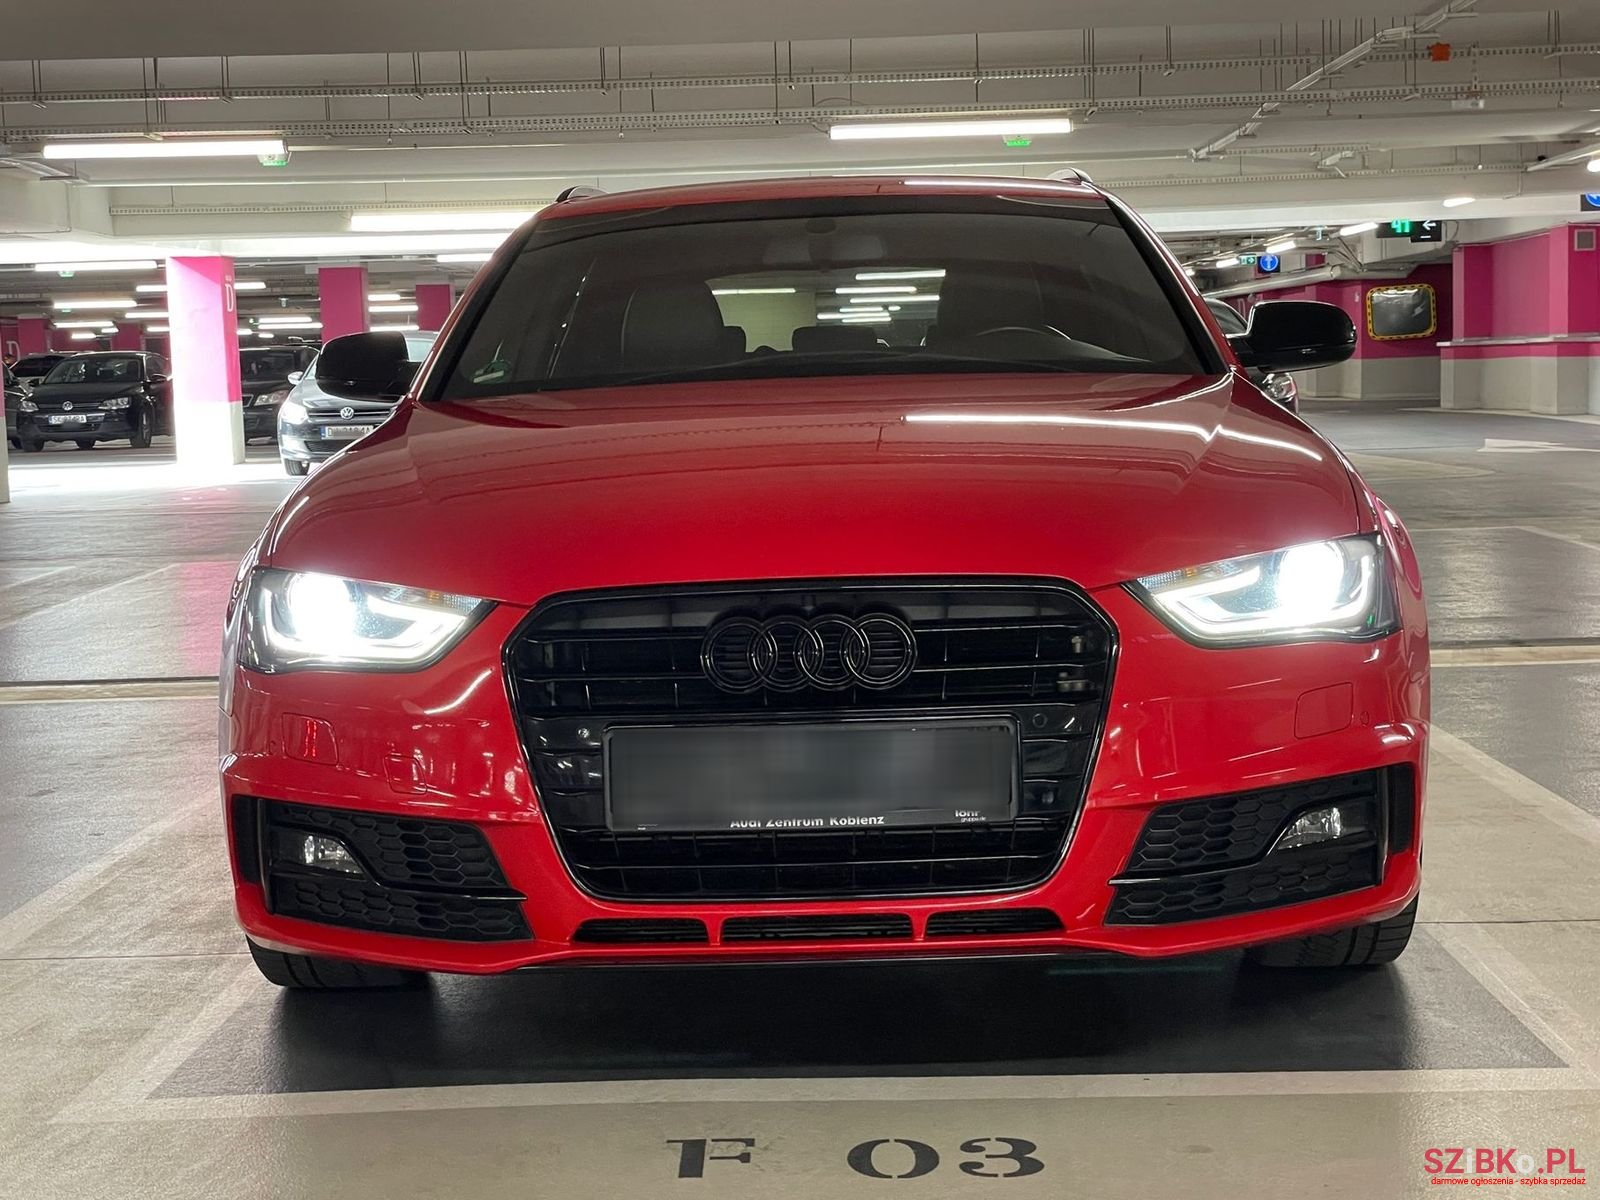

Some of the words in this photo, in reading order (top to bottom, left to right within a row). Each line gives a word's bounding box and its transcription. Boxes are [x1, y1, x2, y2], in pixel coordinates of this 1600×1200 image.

[829, 815, 885, 826] Koblenz
[666, 1137, 756, 1178] F
[846, 1137, 1045, 1179] 03
